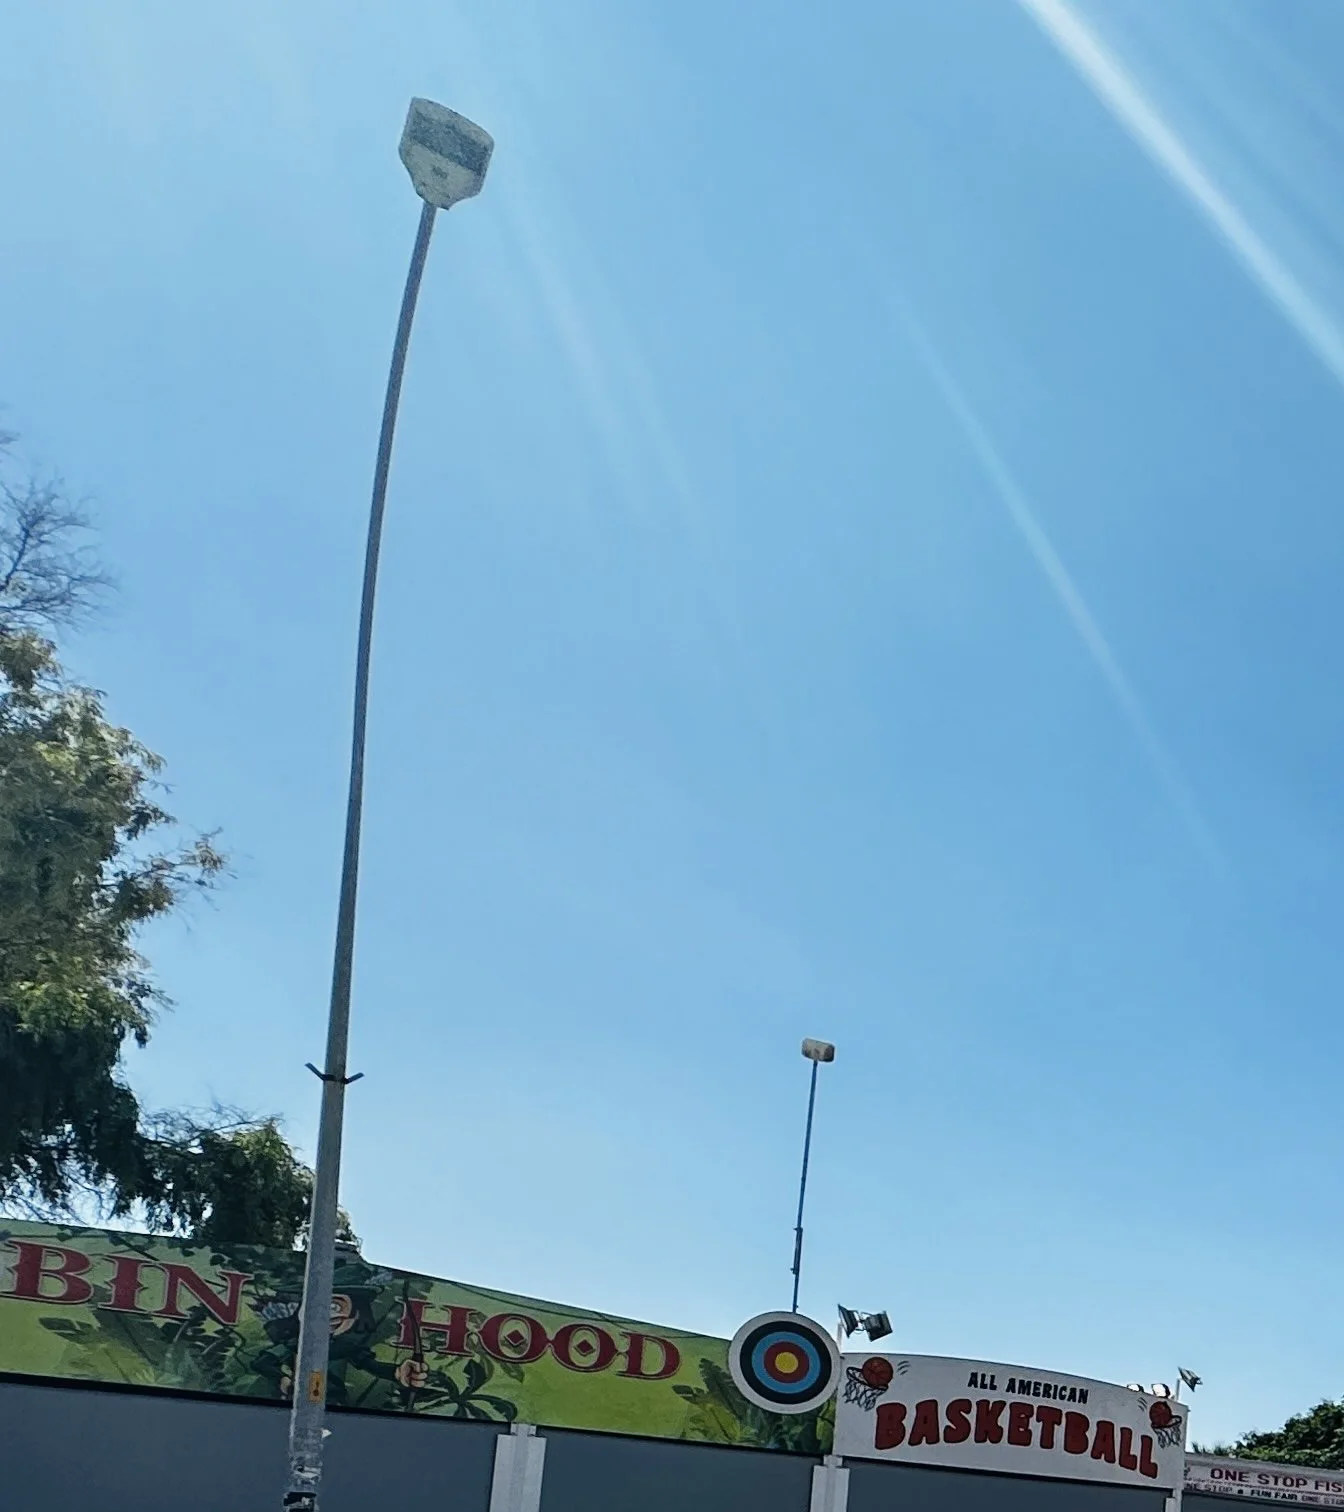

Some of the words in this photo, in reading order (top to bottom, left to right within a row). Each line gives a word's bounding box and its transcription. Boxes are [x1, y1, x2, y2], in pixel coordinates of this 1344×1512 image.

[391, 1296, 682, 1380] HOOD
[968, 1372, 998, 1391] ALL
[1005, 1377, 1089, 1404] AMERICAN
[874, 1399, 1158, 1479] BASKETBALL
[1210, 1468, 1249, 1483] ONE
[1257, 1473, 1307, 1489] STOP
[1251, 1489, 1272, 1499] FUN
[1274, 1492, 1298, 1501] FAIR
